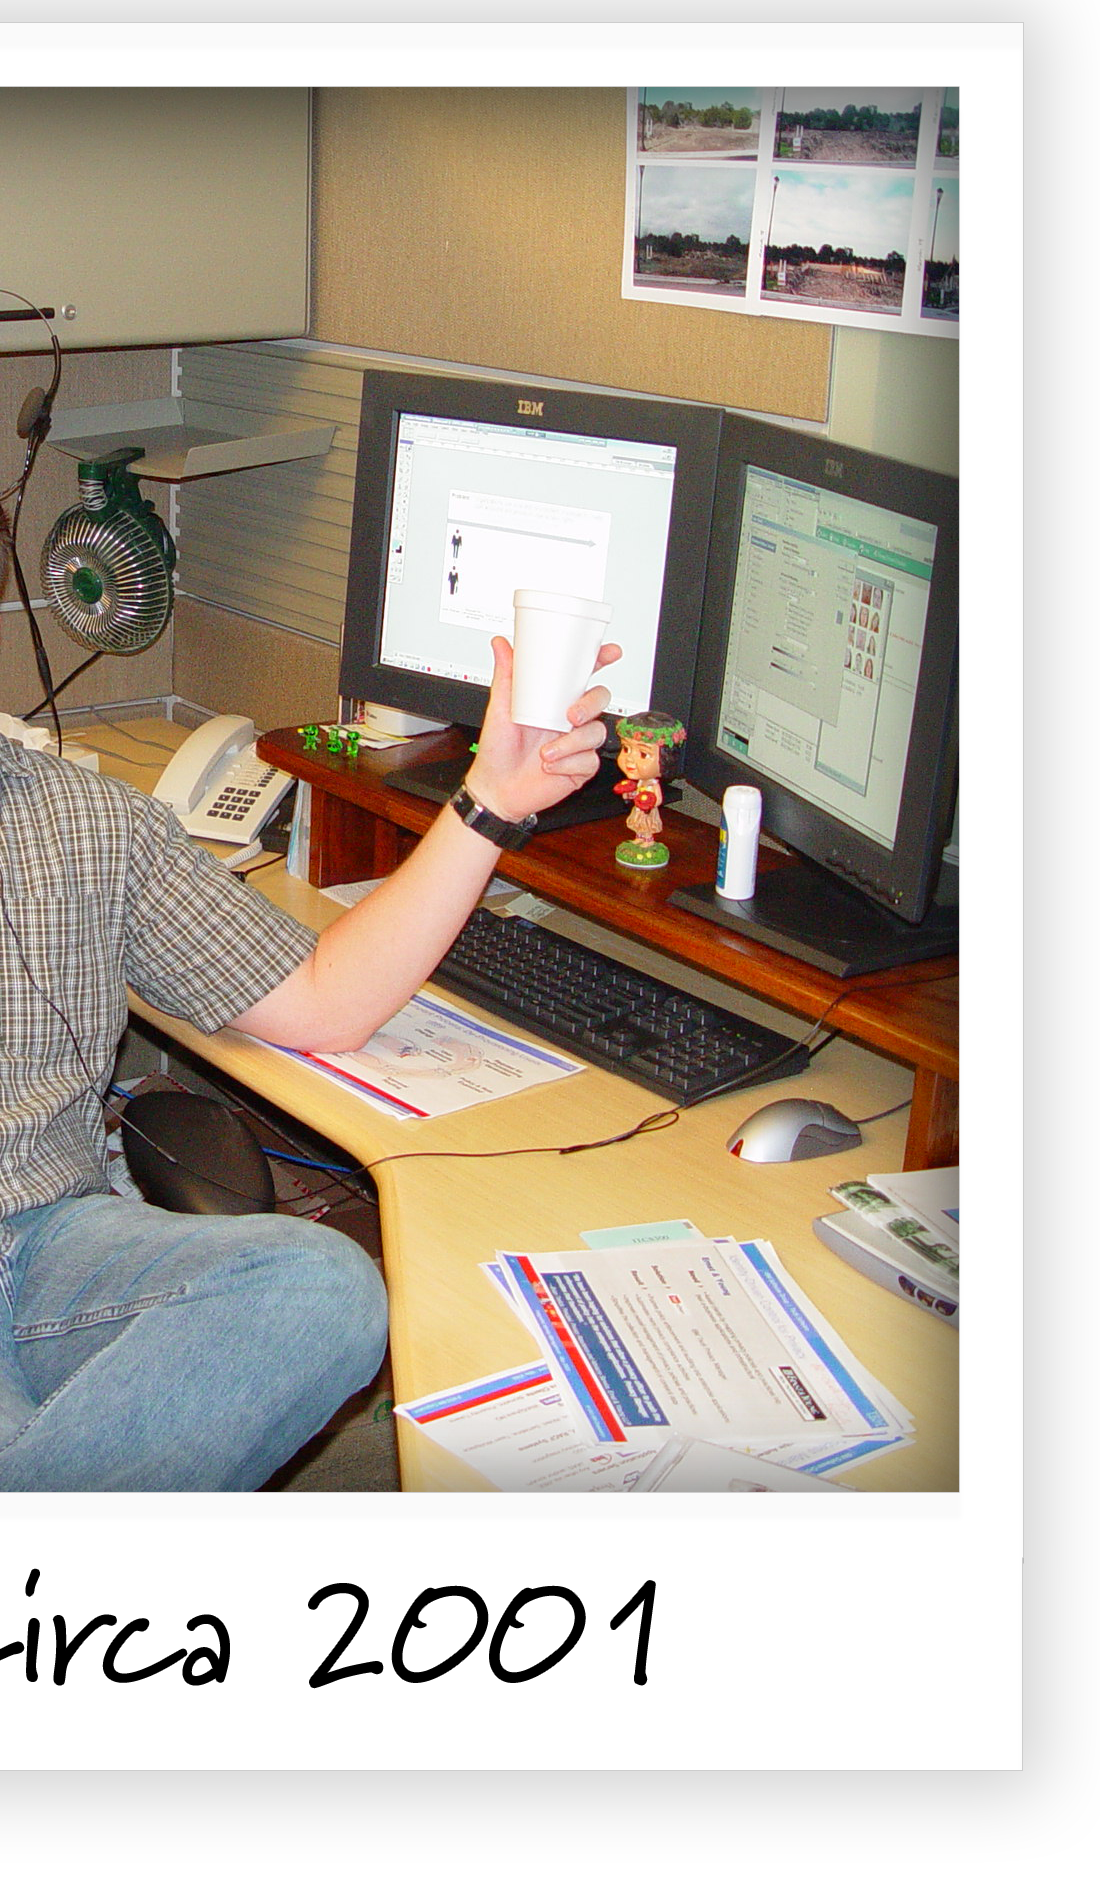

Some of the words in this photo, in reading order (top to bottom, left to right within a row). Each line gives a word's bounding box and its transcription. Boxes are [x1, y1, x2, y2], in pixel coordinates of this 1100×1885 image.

[517, 400, 544, 416] IBM
[714, 1278, 732, 1296] Young
[867, 1410, 887, 1427] IBM
